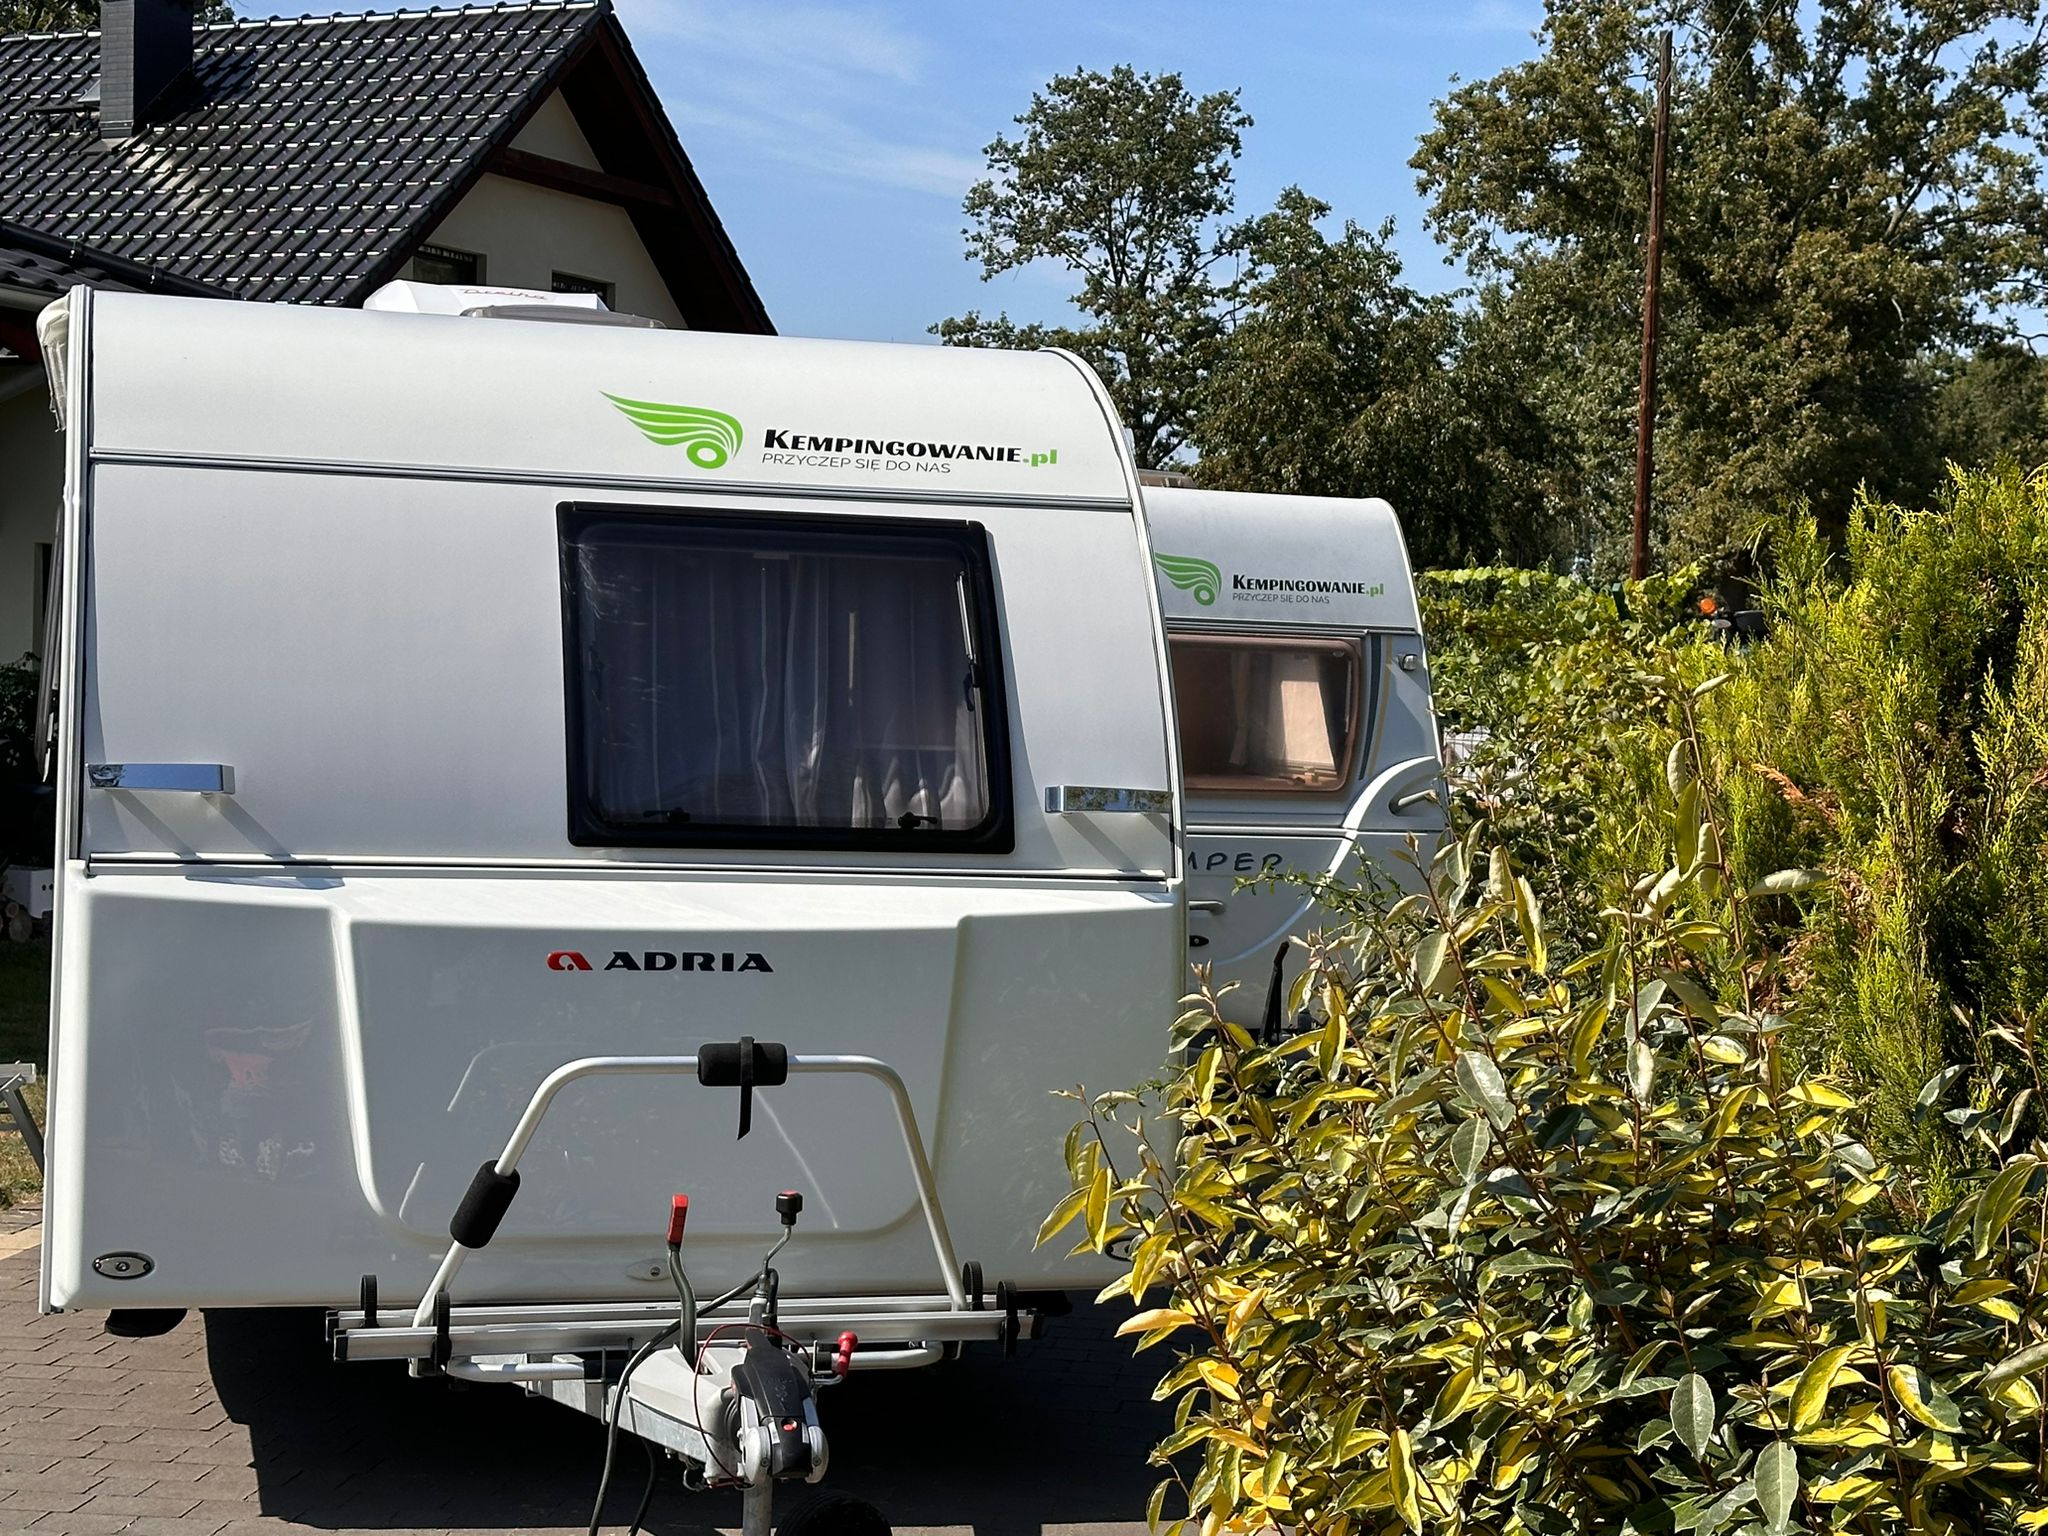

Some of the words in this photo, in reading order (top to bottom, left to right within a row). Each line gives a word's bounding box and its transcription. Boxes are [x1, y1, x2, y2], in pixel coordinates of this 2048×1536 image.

[762, 453, 851, 468] PRZYCZEP
[855, 458, 880, 472] SIĘ
[885, 460, 911, 471] DO
[916, 462, 951, 473] NAS
[1232, 592, 1279, 602] PRZYCZEP
[1296, 595, 1310, 603] DO
[1311, 595, 1330, 604] NAS
[604, 951, 774, 973] ADRIA
